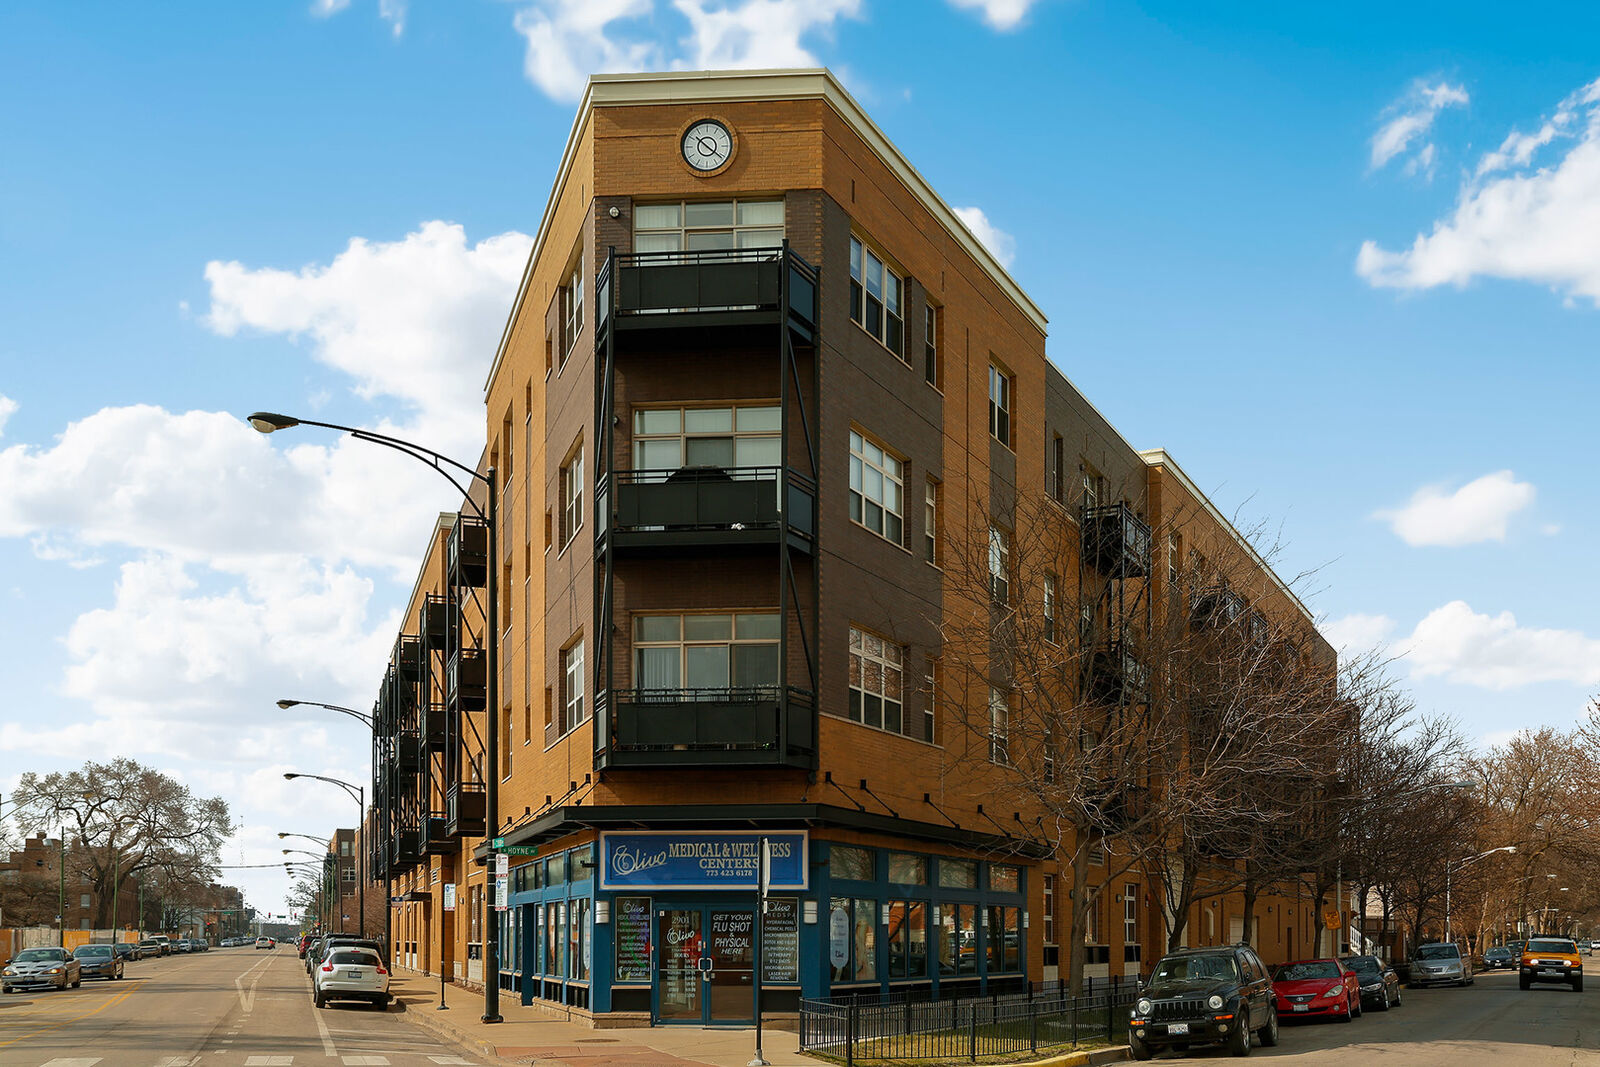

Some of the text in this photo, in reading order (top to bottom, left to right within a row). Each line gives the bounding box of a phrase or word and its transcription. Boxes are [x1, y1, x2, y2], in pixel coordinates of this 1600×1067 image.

[668, 842, 791, 858] MEDICAL & WELESS
[699, 858, 760, 869] CENTERS
[672, 916, 690, 924] 2901
[712, 922, 752, 932] FLU SHOT
[714, 938, 750, 948] PHYSICAL
